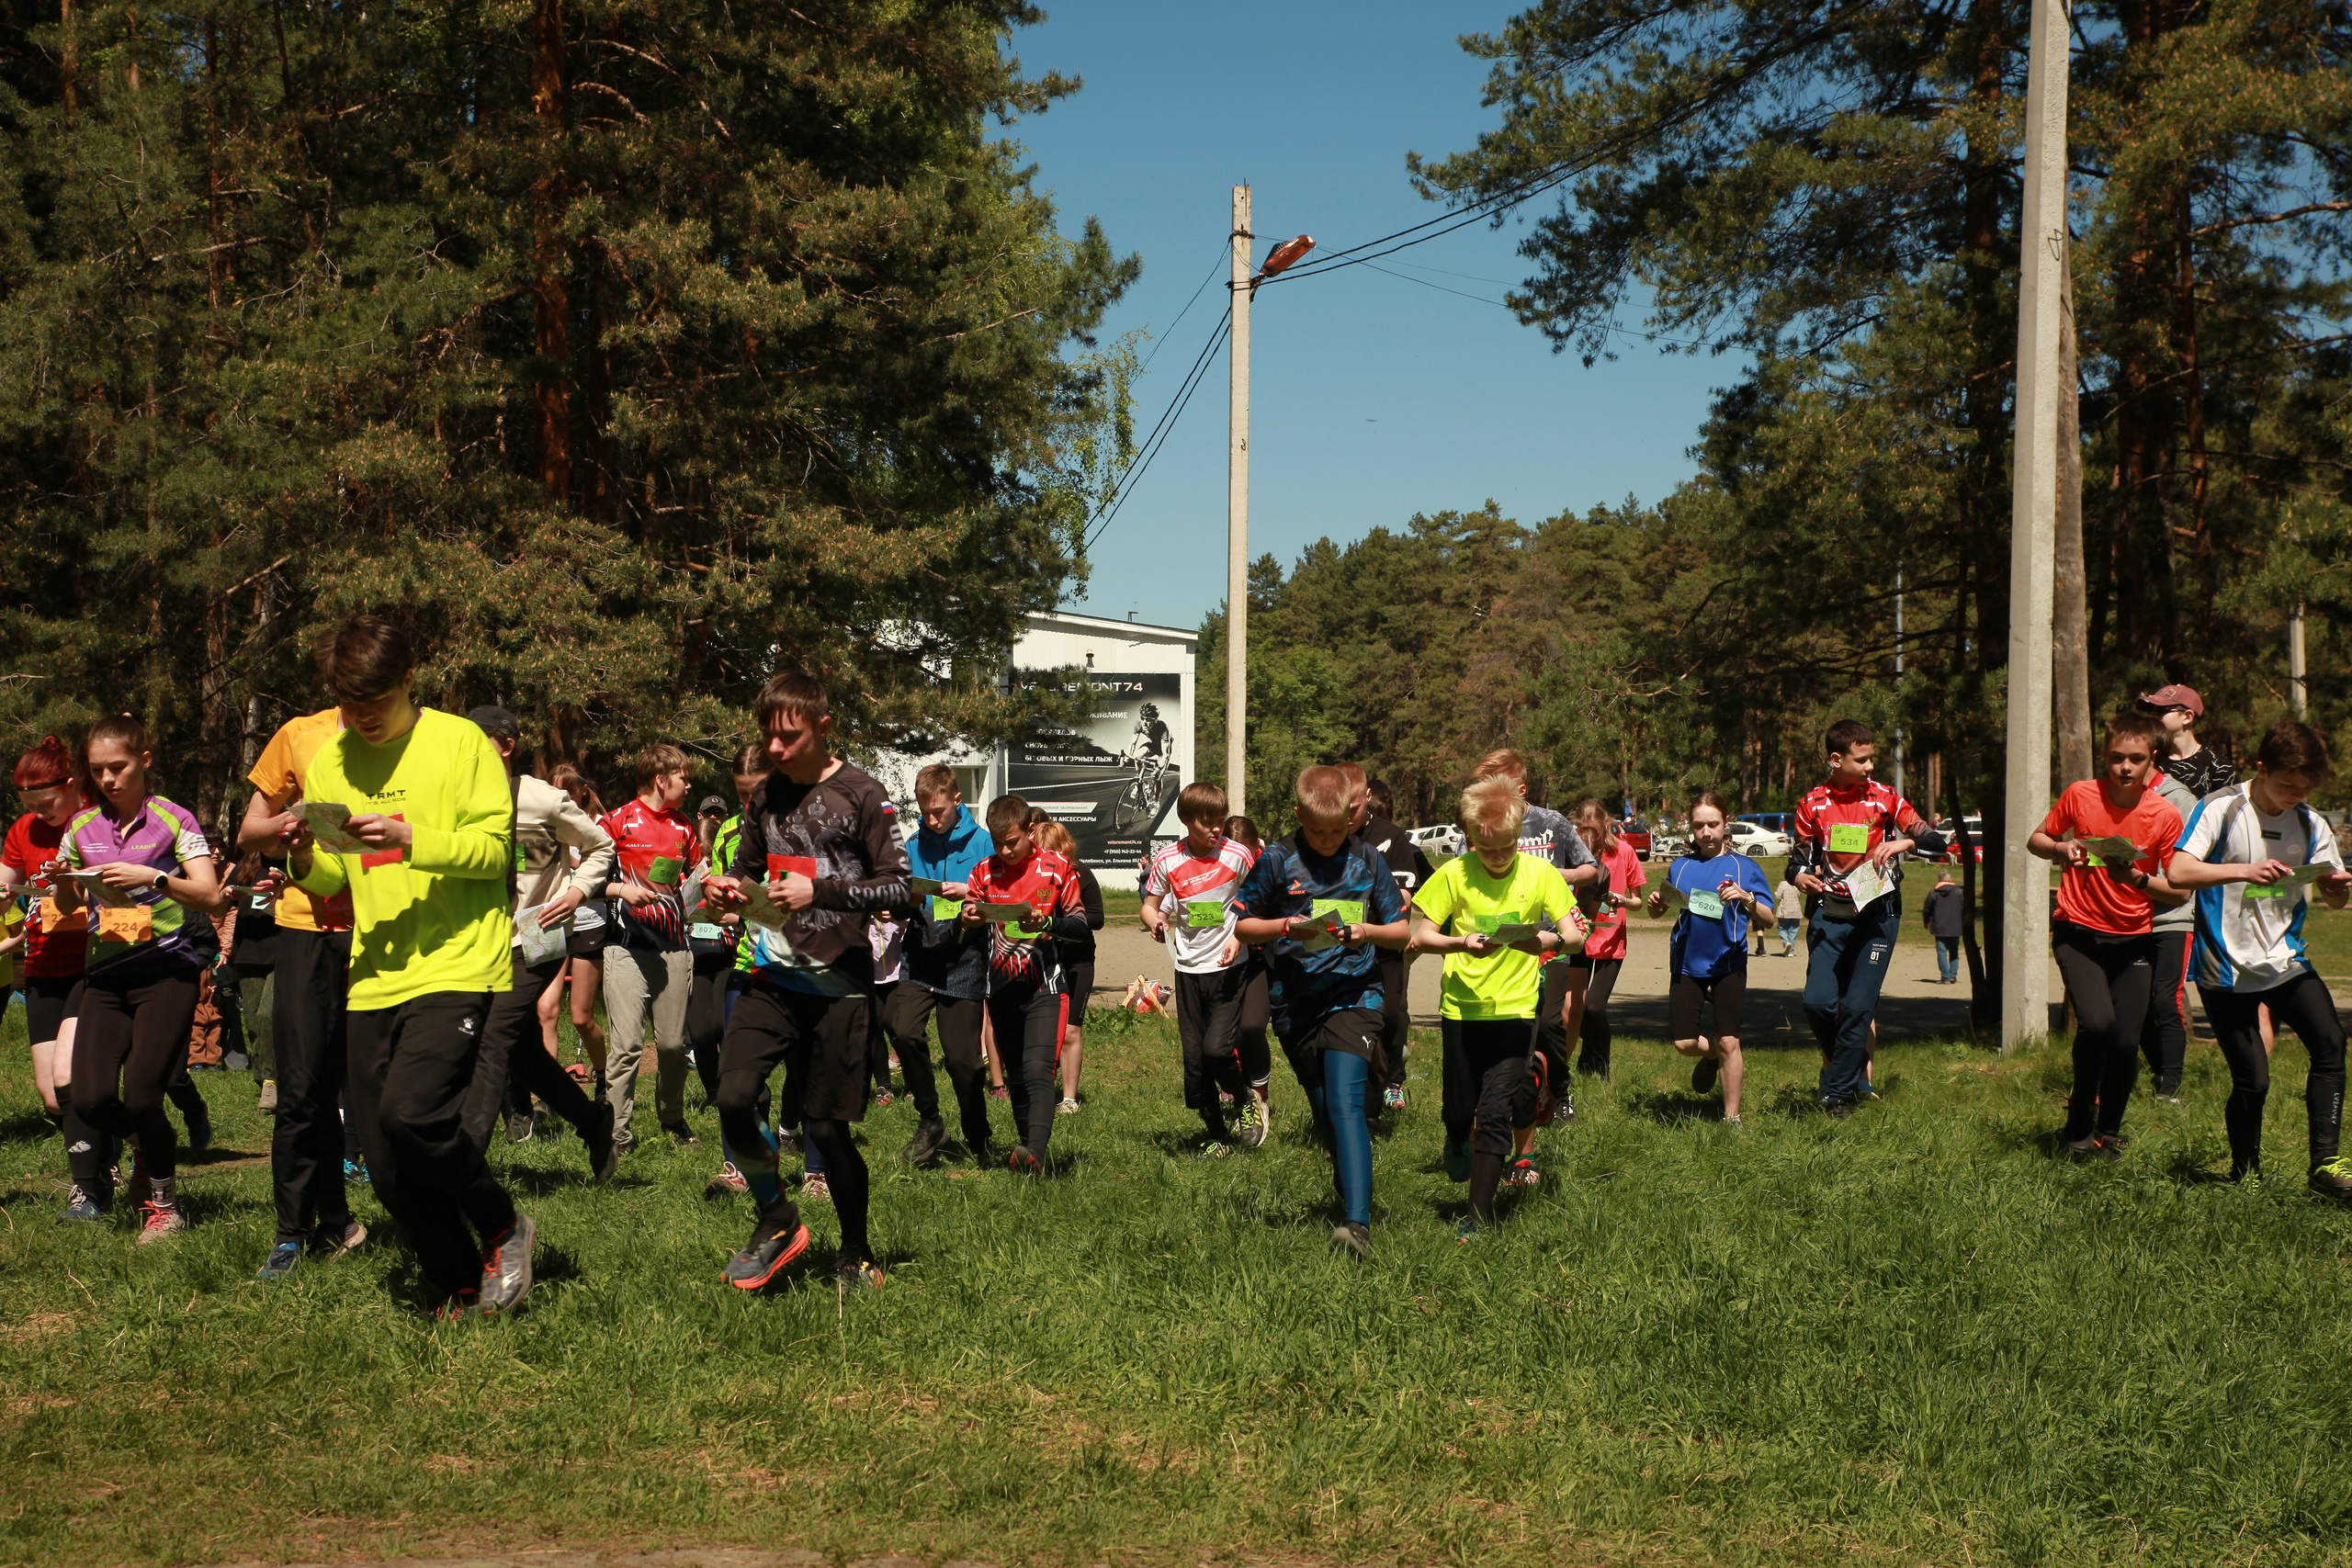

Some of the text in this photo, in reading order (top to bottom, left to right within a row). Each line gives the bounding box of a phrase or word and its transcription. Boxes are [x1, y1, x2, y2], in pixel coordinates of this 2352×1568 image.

[1020, 682, 1144, 692] VEREONT74
[366, 789, 406, 800] TRMT
[131, 842, 156, 851] LEADER
[1840, 838, 1859, 846] 534
[944, 904, 960, 912] 521
[1698, 901, 1715, 911] 620
[113, 922, 138, 932] 224
[1870, 951, 1879, 961] 01
